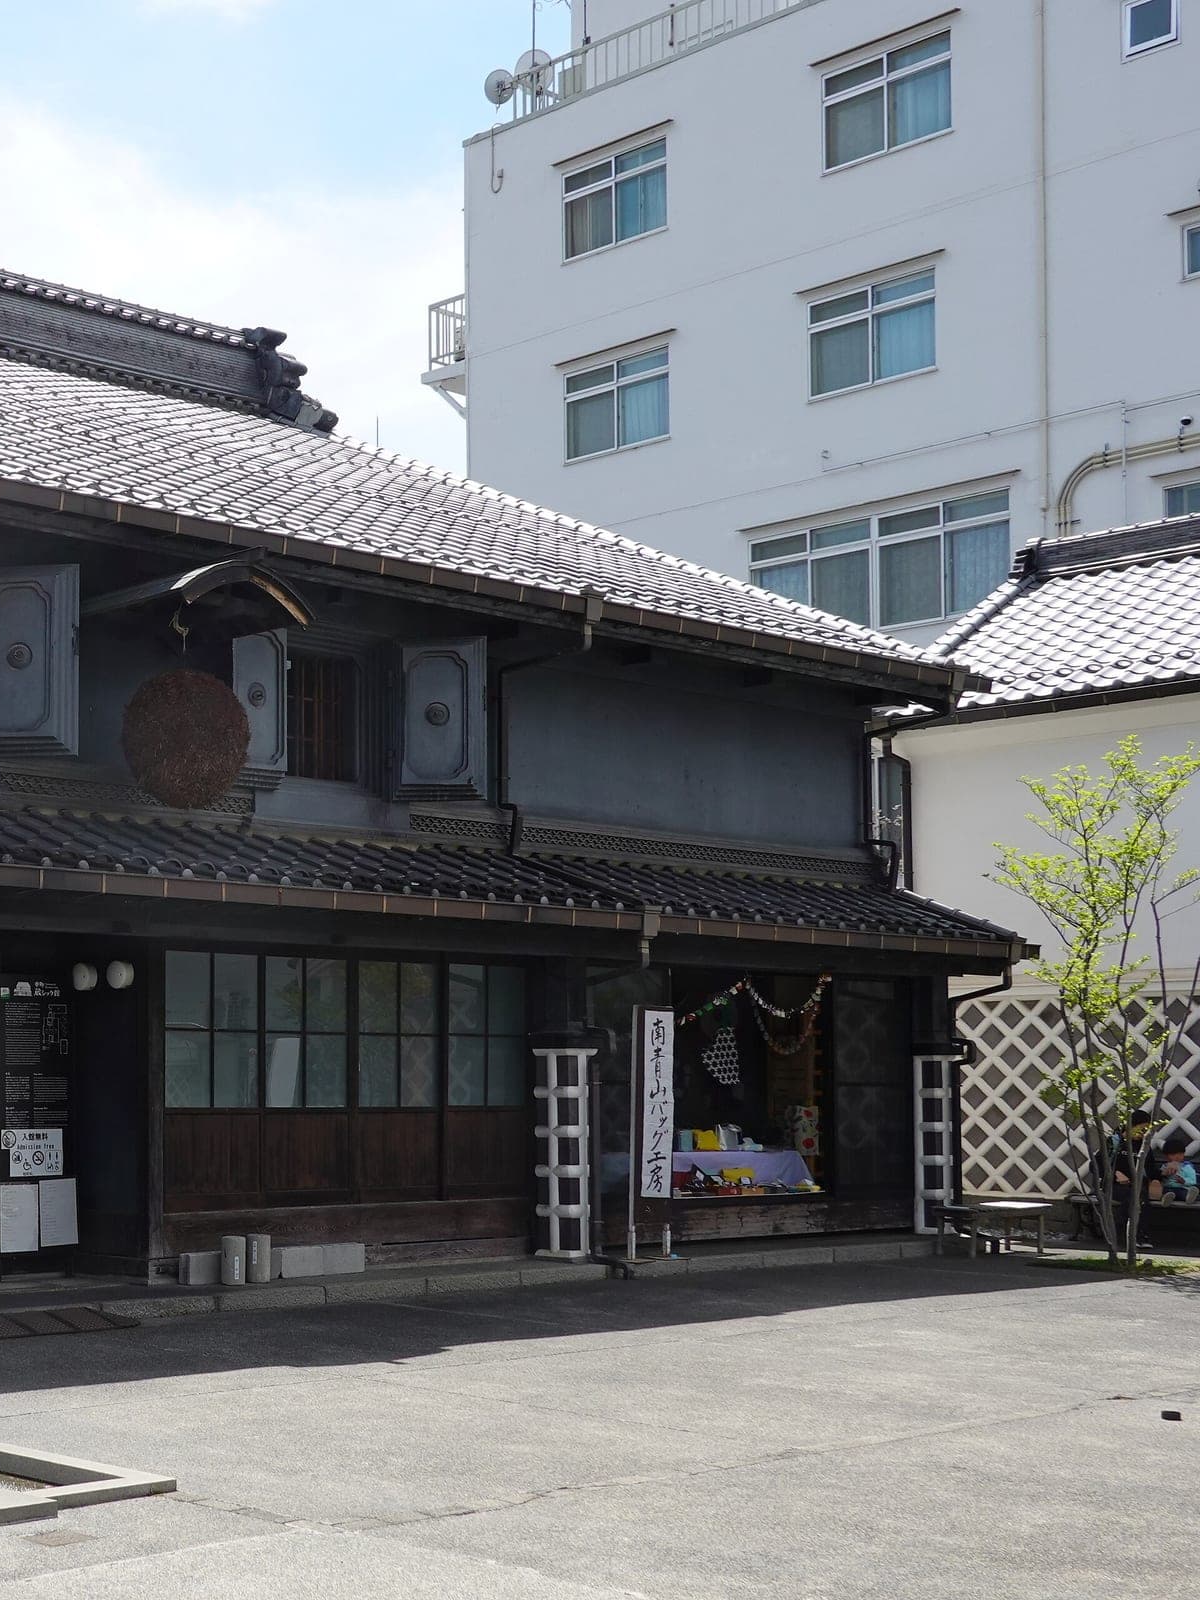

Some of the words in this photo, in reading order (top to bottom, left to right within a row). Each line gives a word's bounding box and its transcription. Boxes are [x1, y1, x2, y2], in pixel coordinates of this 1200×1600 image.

[646, 1018, 669, 1193] 南青山バッグ工房
